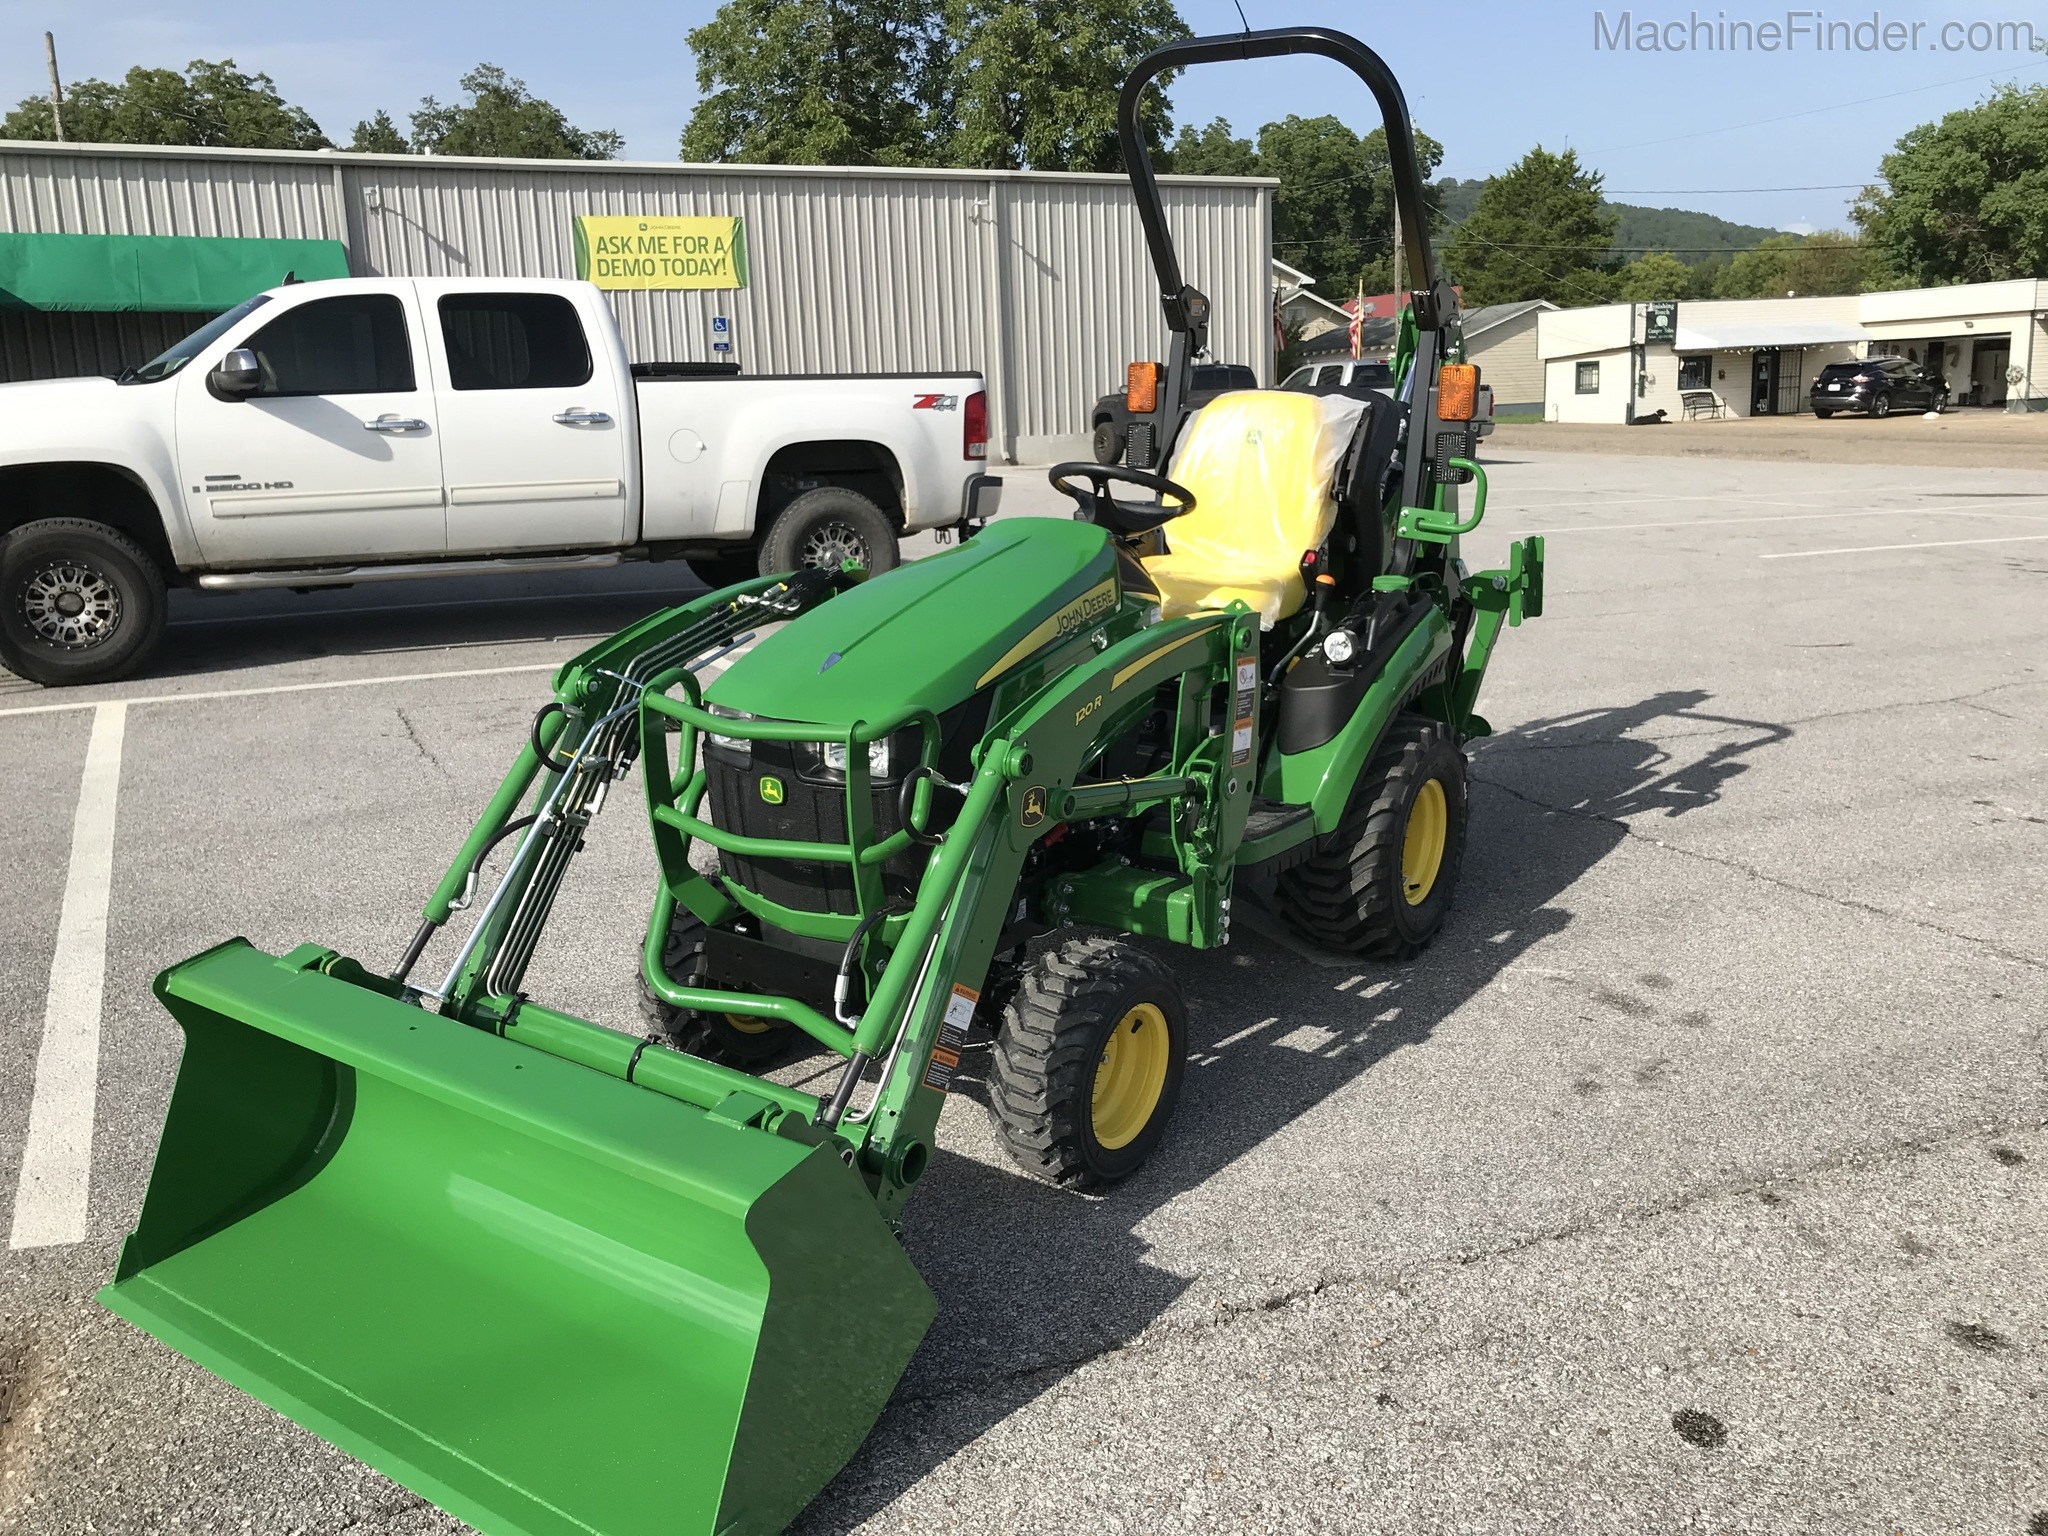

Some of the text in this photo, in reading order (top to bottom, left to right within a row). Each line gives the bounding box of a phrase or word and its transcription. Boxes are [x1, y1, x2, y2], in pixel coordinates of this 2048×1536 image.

[596, 236, 726, 255] ASK ME FOR A
[597, 258, 727, 277] DEMO TODAY!
[1056, 590, 1113, 634] JOHN DEERE
[1075, 695, 1102, 726] 120 R
